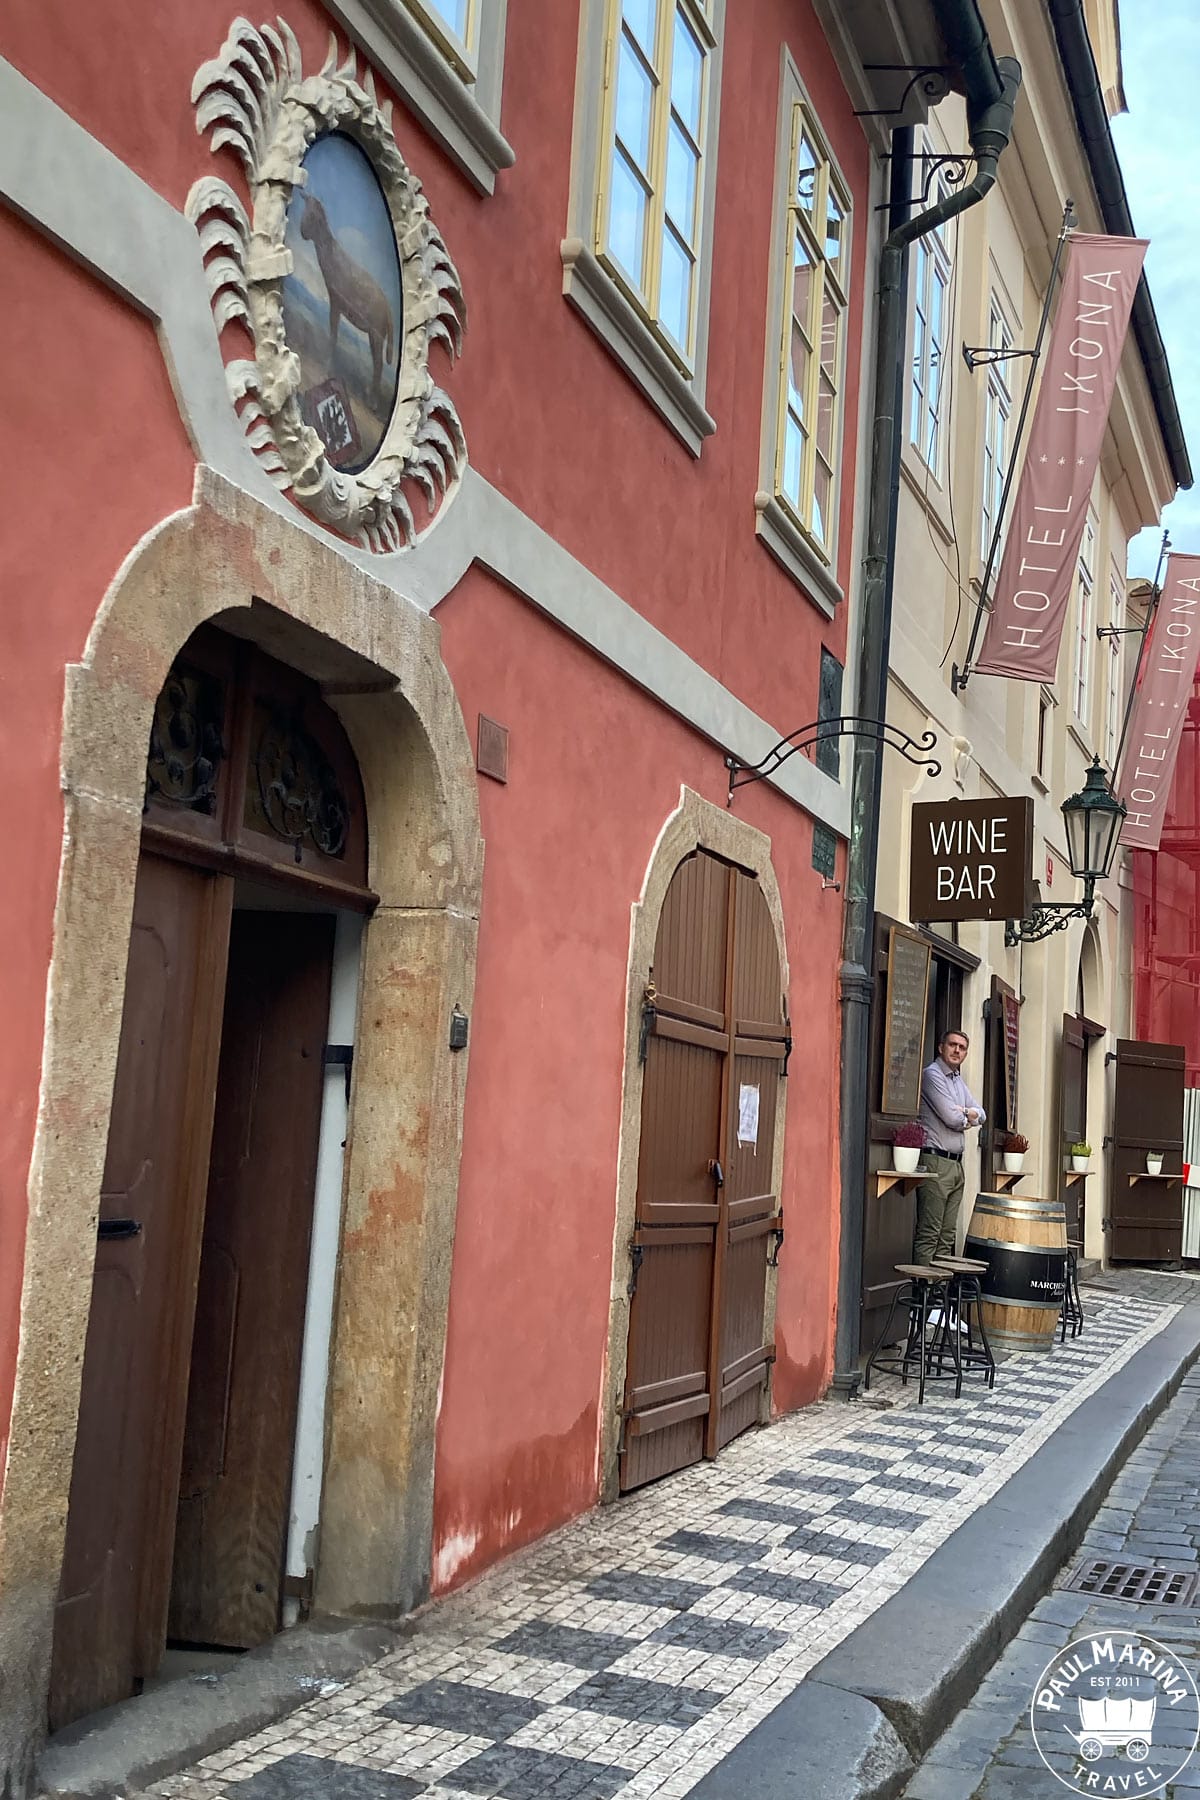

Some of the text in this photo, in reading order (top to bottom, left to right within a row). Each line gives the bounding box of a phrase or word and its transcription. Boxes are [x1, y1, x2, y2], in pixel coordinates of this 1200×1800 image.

[1003, 269, 1122, 649] HOTEL IKONA
[1124, 576, 1200, 828] HOTEL IKONA
[929, 817, 1008, 856] WINE
[936, 864, 996, 902] BAR
